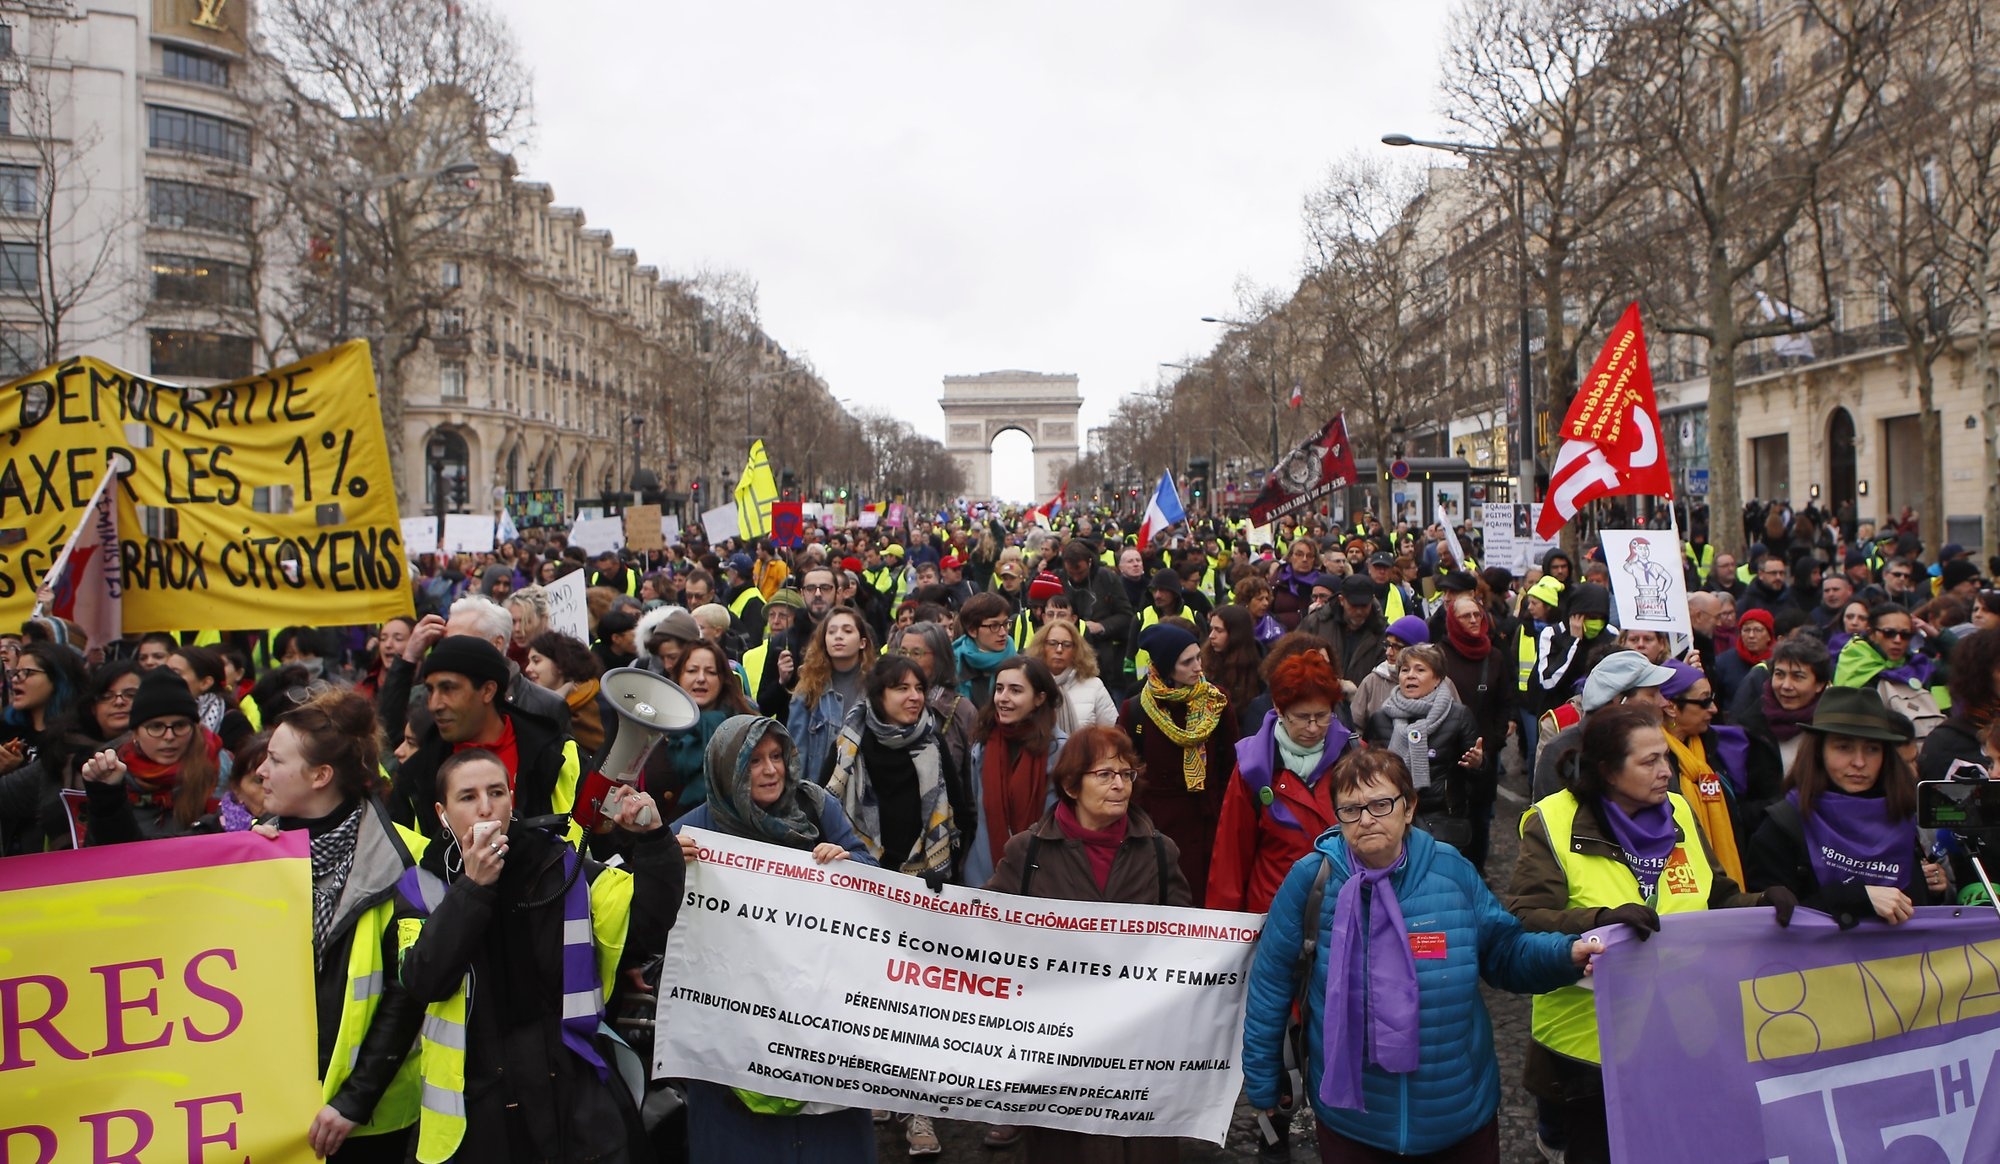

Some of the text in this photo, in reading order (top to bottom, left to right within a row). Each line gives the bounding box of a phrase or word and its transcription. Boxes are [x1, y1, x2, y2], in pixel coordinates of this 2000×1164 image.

[16, 355, 315, 431] DÉMOCRATIE
[163, 445, 240, 506] LES
[284, 429, 369, 502] 1%
[1700, 781, 1720, 795] cgt
[695, 847, 765, 871] OLLECTIF
[767, 861, 825, 883] FEMMES
[830, 873, 885, 897] CONTRE
[888, 886, 911, 904] LES
[1005, 909, 1022, 923] LE
[1024, 911, 1097, 932] CHÔMAGE
[1100, 918, 1117, 932] ET
[1120, 919, 1144, 934] LES
[1664, 863, 1695, 884] cgt
[1821, 846, 1900, 874] #8mars15h40
[686, 891, 1247, 986] STOP AUX VIOLENCES ÉCONOMIQUES FAITES AUX FEMMES !
[0, 948, 244, 1072] RES
[886, 958, 1011, 1000] URGENCE
[670, 986, 1231, 1072] ATTRIBUTION DES ALLOCATIONS DE MINIMA SOCIAUX À TITRE INDIVIDUEL ET NON FAMILIAL
[845, 991, 1074, 1038] PÉRENNISATION DES EMPLOIS AIDÉS
[1752, 961, 1821, 1070] 8
[747, 1061, 1155, 1121] ABROGATION DES ORDONNANCES DE CASSE DU CODE DU TRAVAIL
[768, 1041, 1150, 1101] CENTRES D'HÉBERGEMENT POUR LES FEMMES EN PRÉCARITÉ
